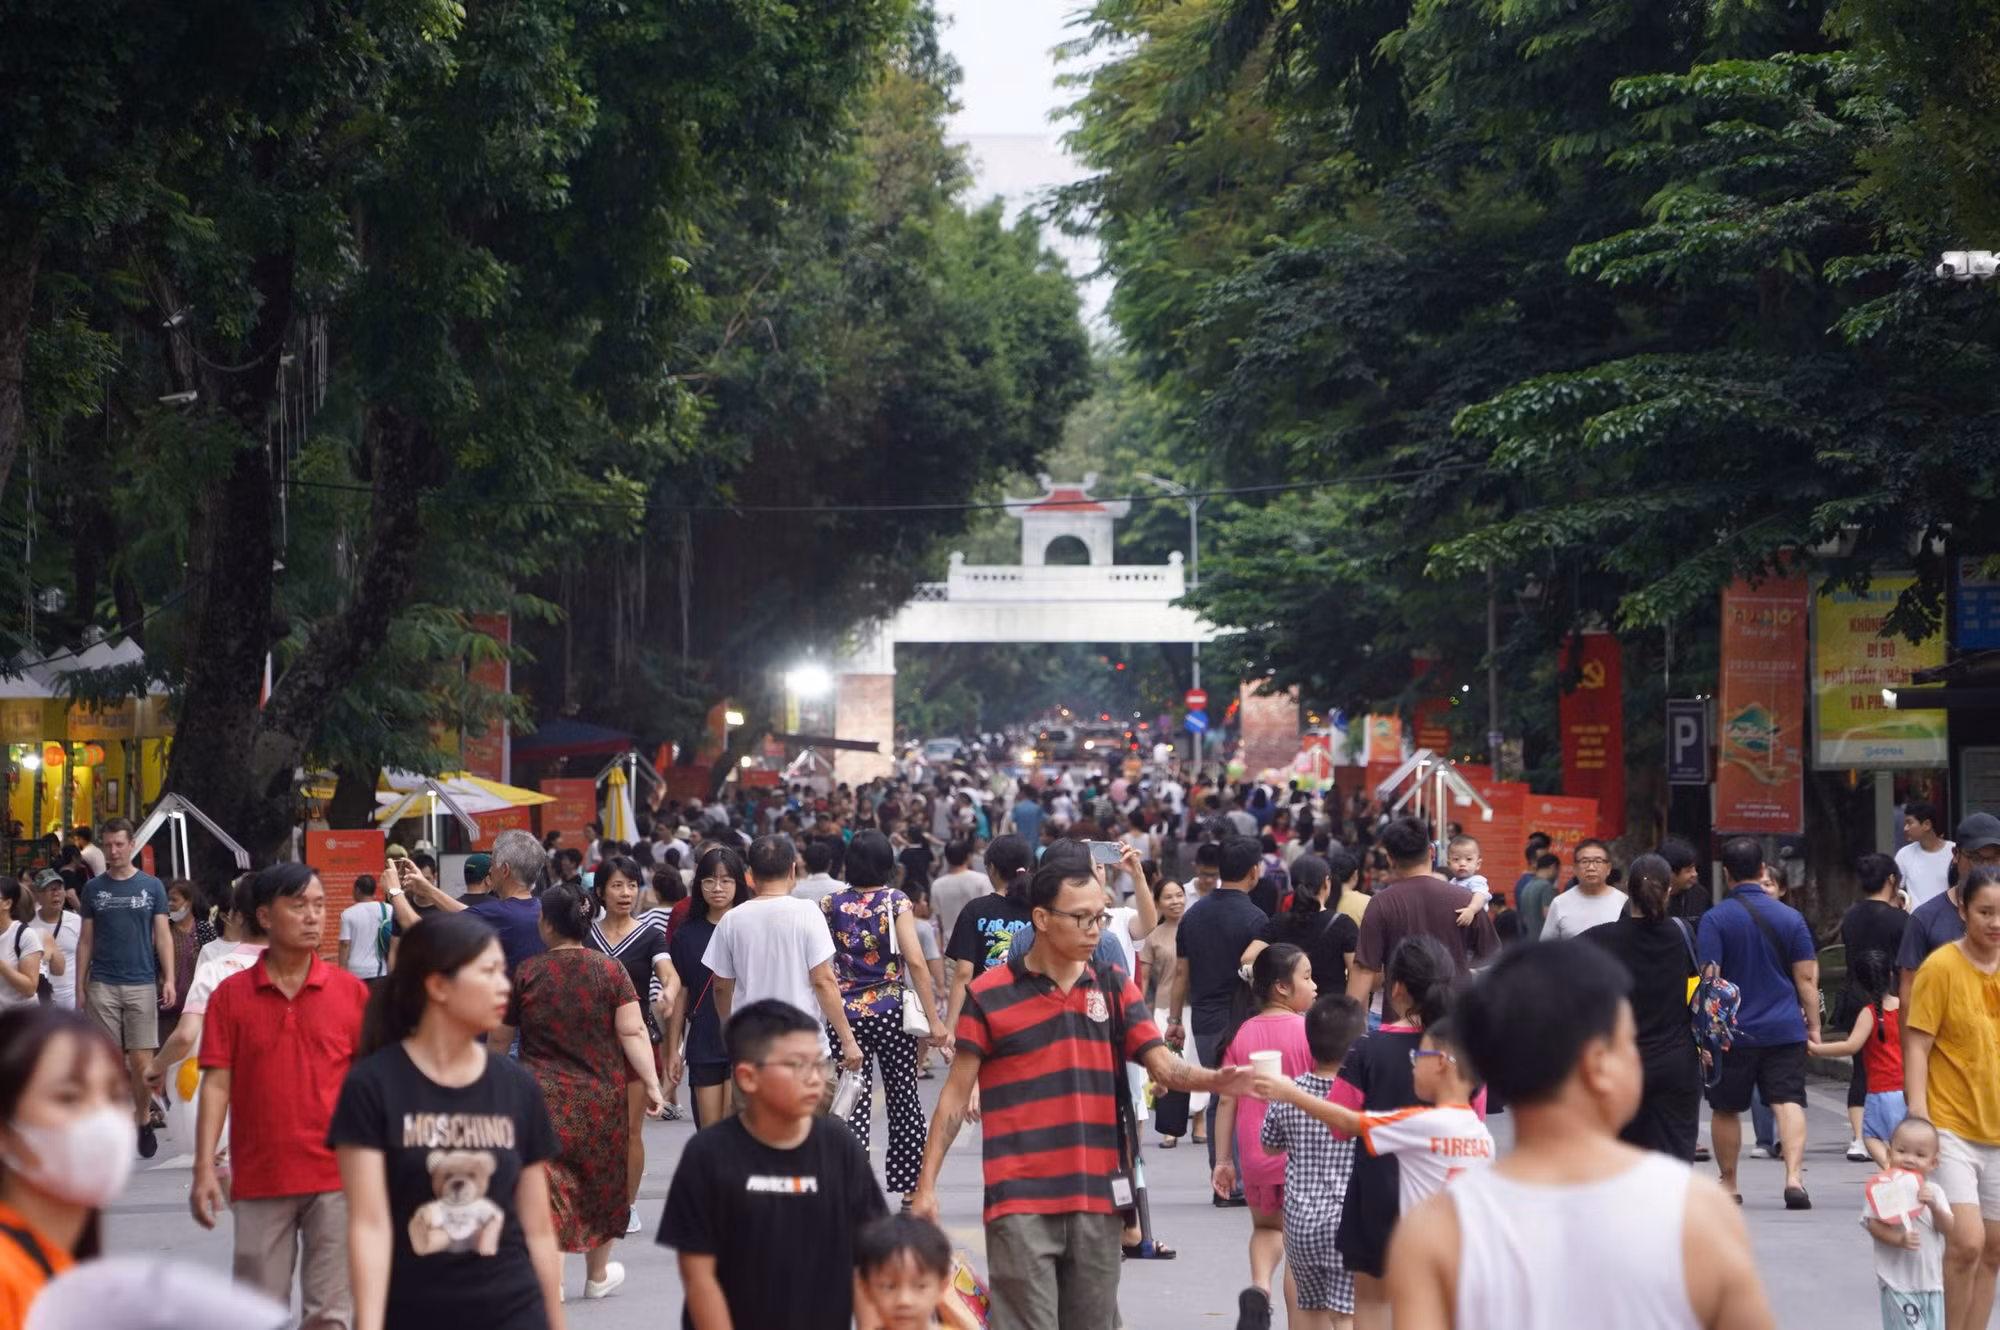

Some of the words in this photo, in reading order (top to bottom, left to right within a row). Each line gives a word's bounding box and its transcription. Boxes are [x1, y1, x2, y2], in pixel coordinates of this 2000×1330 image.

[1675, 716, 1698, 764] P
[977, 917, 1031, 933] PARAD
[403, 1112, 515, 1150] MOSCHINO
[1903, 1303, 1920, 1326] 9
